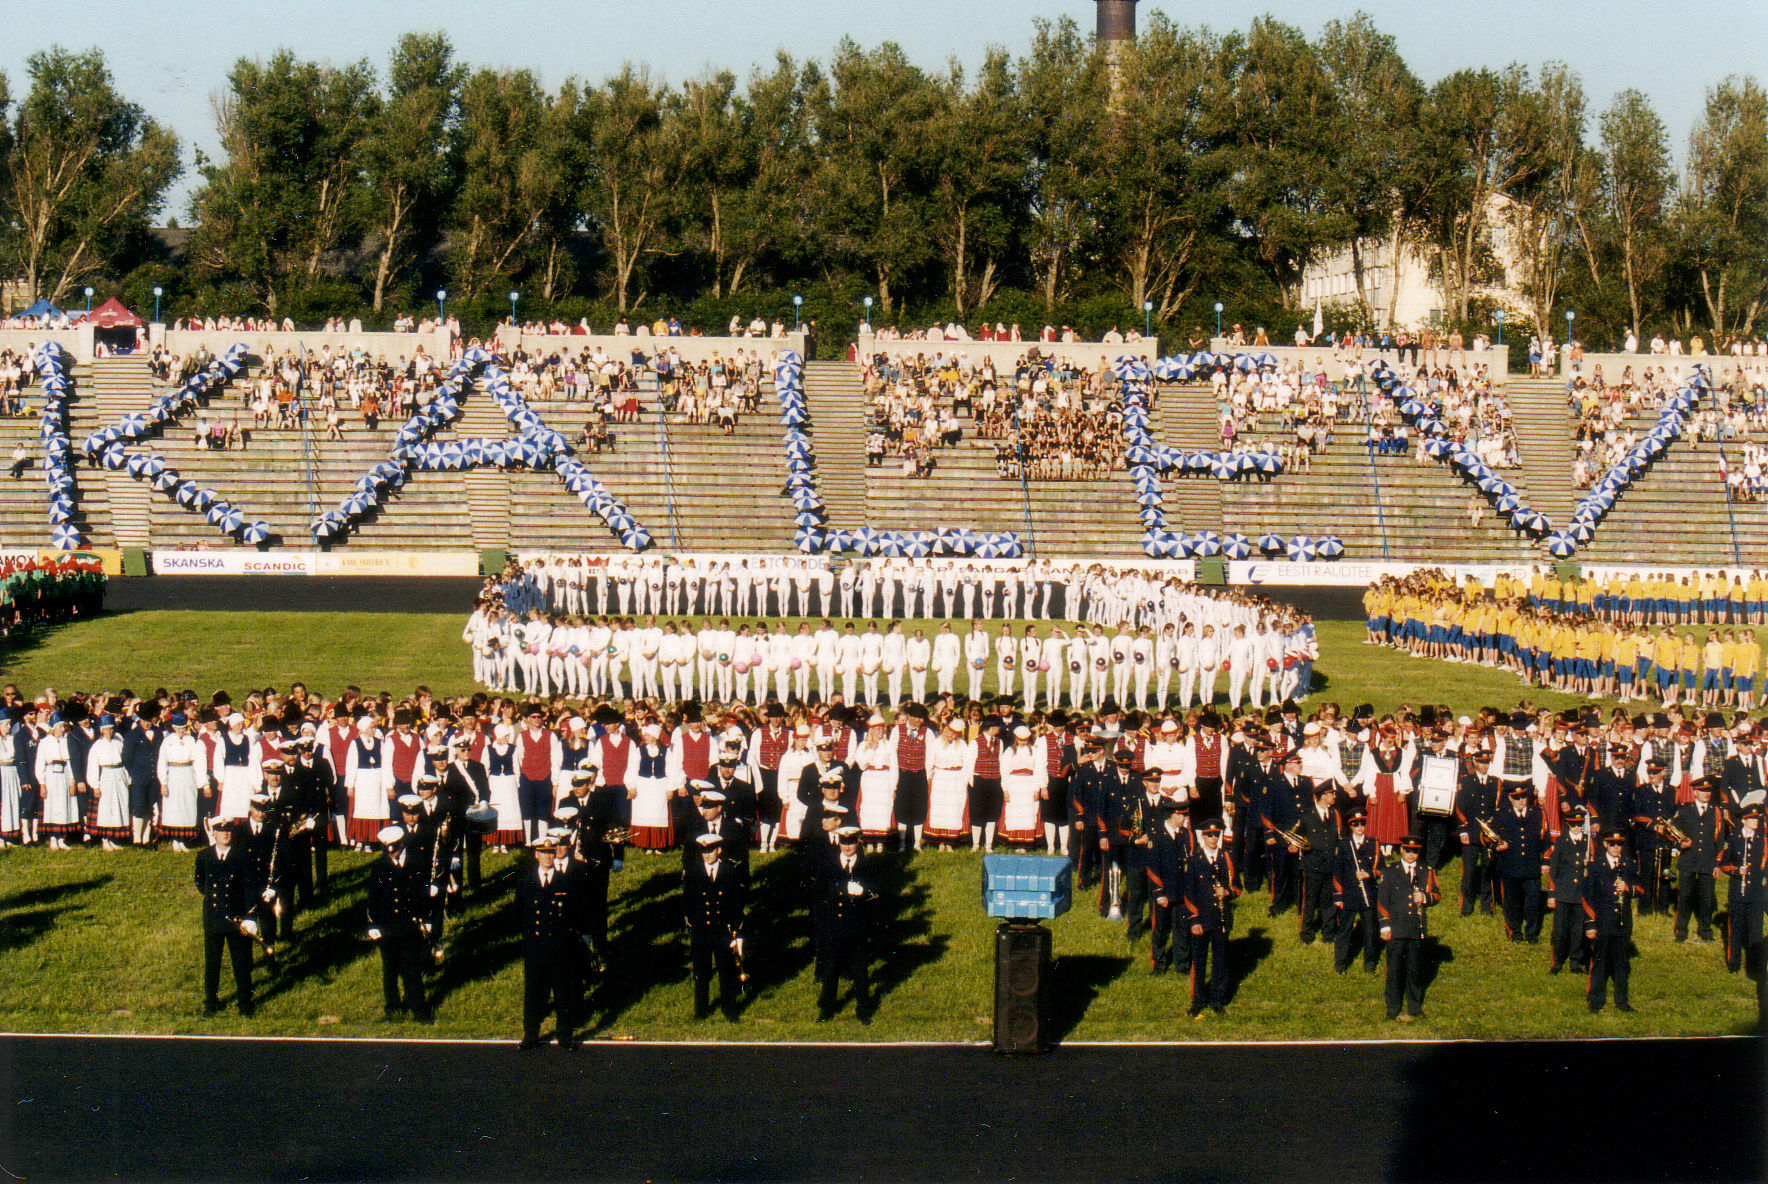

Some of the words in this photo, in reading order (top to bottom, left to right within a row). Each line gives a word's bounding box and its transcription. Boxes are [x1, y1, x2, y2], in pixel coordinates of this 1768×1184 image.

[163, 558, 225, 568] SKANSKA
[244, 562, 306, 571] SCANDIC
[1278, 565, 1311, 577] EESTI
[1314, 565, 1372, 578] RAUDTEE
